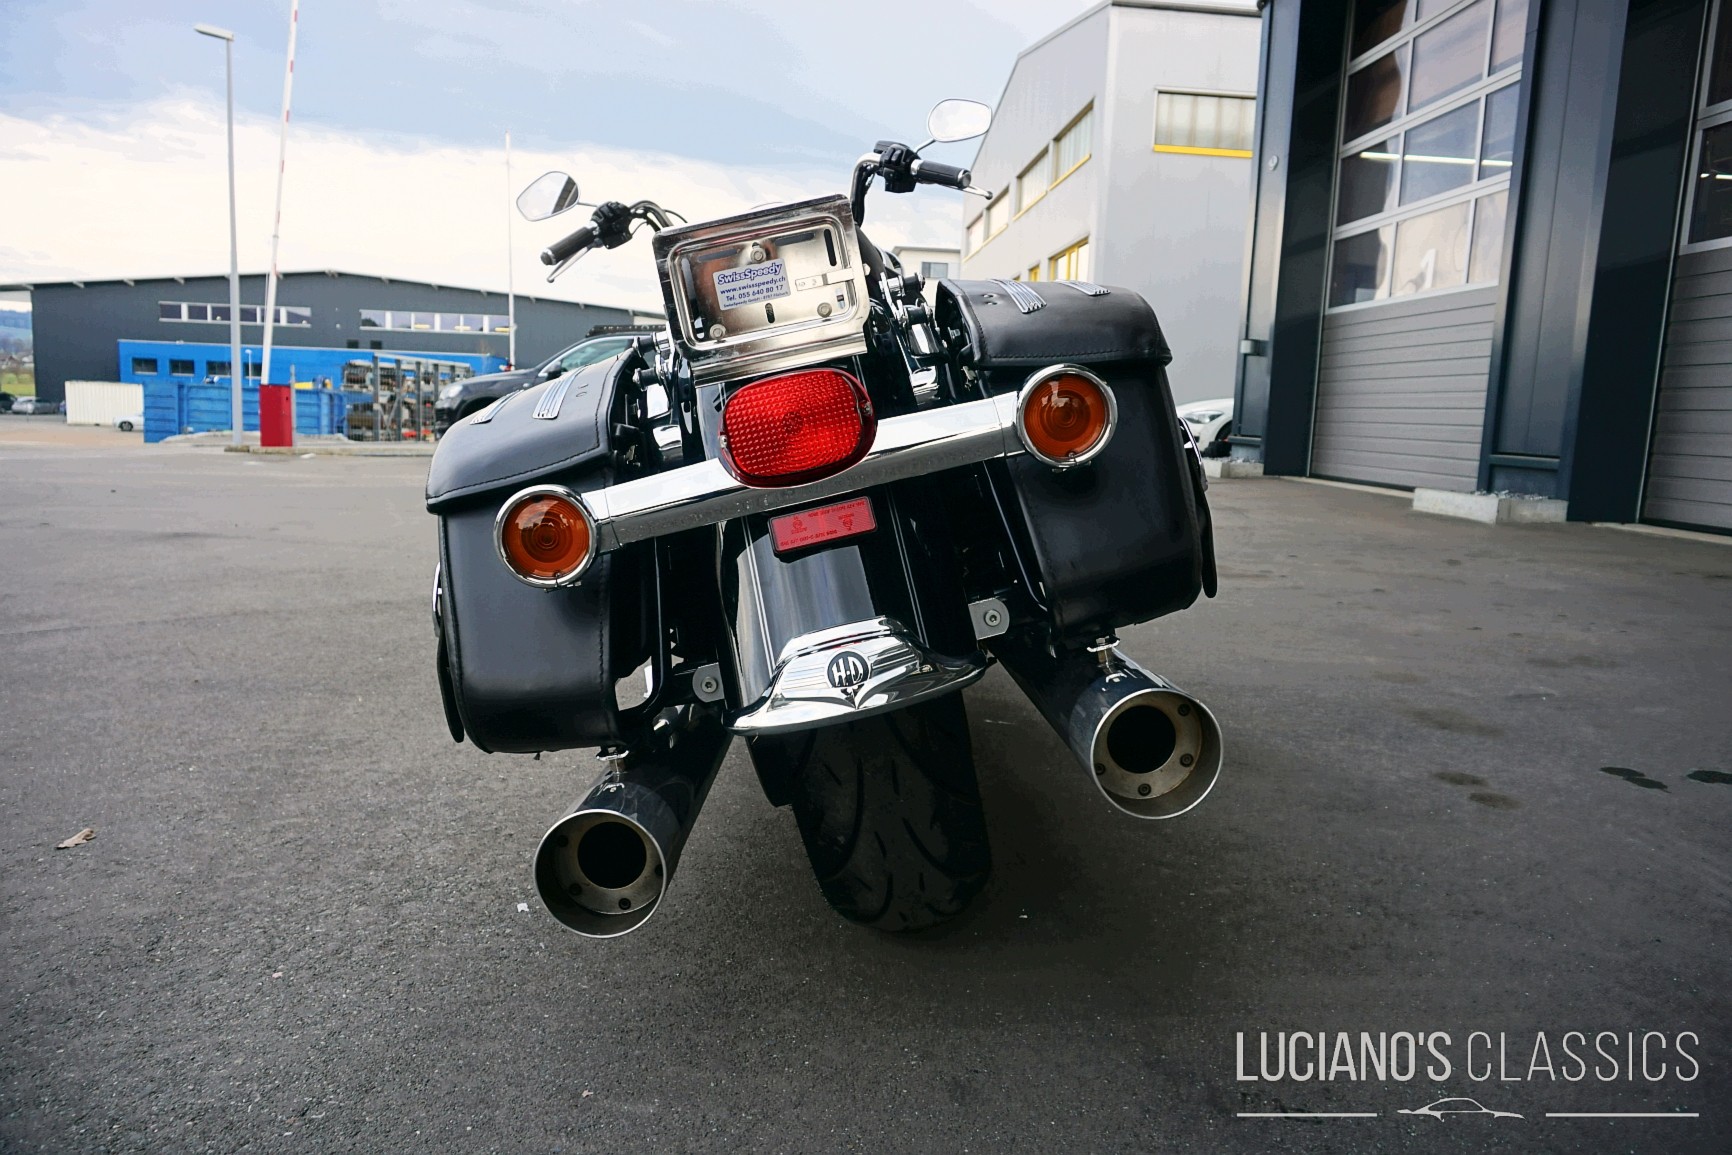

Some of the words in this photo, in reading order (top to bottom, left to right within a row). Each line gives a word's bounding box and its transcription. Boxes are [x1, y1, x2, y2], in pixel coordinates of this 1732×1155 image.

[718, 262, 782, 285] SwissSpeedy
[720, 276, 786, 295] www.swissspeedy.ch
[738, 291, 750, 299] 055
[752, 289, 764, 297] 640
